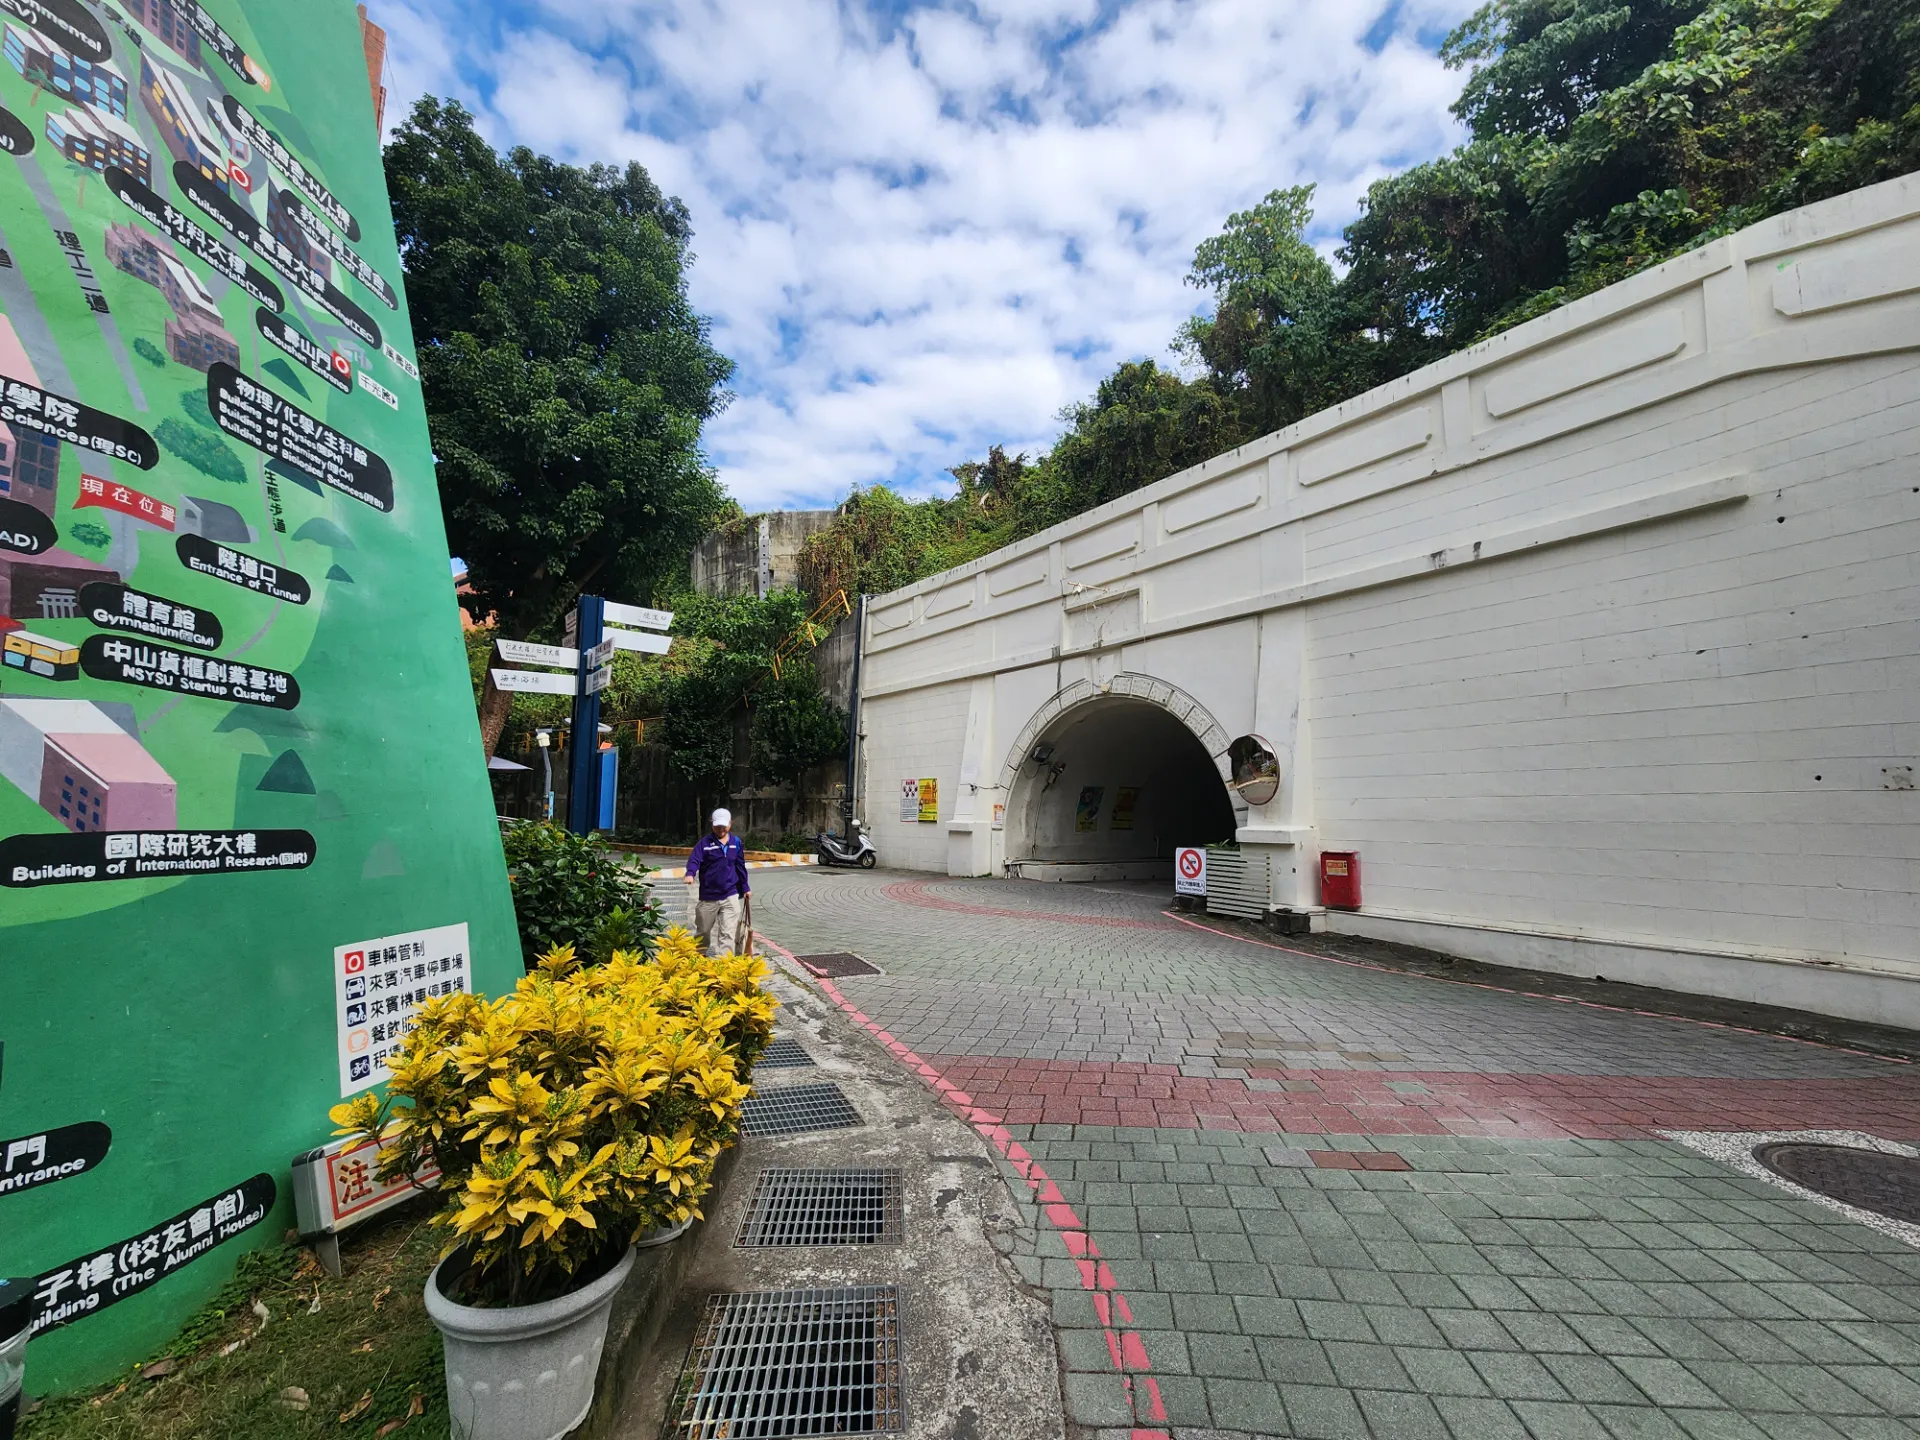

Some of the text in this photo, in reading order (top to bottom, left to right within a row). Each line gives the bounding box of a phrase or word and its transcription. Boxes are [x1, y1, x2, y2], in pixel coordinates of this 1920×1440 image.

[119, 188, 172, 236] Building
[178, 234, 192, 248] of
[163, 203, 248, 278] 材料大樓
[187, 187, 235, 232] Building
[237, 230, 250, 243] of
[253, 240, 298, 283] Electrical
[286, 206, 320, 243] Faculty
[258, 226, 326, 294] 電資大樓
[263, 324, 351, 394] Shoushan Entrance
[283, 323, 333, 372] 壽山門
[218, 387, 264, 421] Building
[265, 416, 279, 429] of
[218, 400, 264, 435] Building
[265, 429, 279, 442] of
[219, 414, 264, 448] Building
[266, 442, 279, 455] of
[281, 448, 325, 480] Biological
[81, 477, 177, 524] 現在位置
[189, 555, 302, 603] Entrance of Tunnel
[218, 546, 278, 585] 隧道口
[123, 590, 197, 632] 體育館
[103, 639, 289, 695] 中山貨櫃創業基地
[122, 663, 278, 704] NSYSU Startup Quarter
[12, 863, 97, 883] Building
[105, 859, 128, 875] of
[135, 856, 221, 873] International
[104, 832, 258, 860] 國際研究大樓
[367, 940, 426, 968] 車輛管制
[369, 953, 464, 993] 來賓汽車停車場
[112, 1266, 156, 1296] (The
[163, 1231, 214, 1271] Alumni
[219, 1203, 264, 1239] House)
